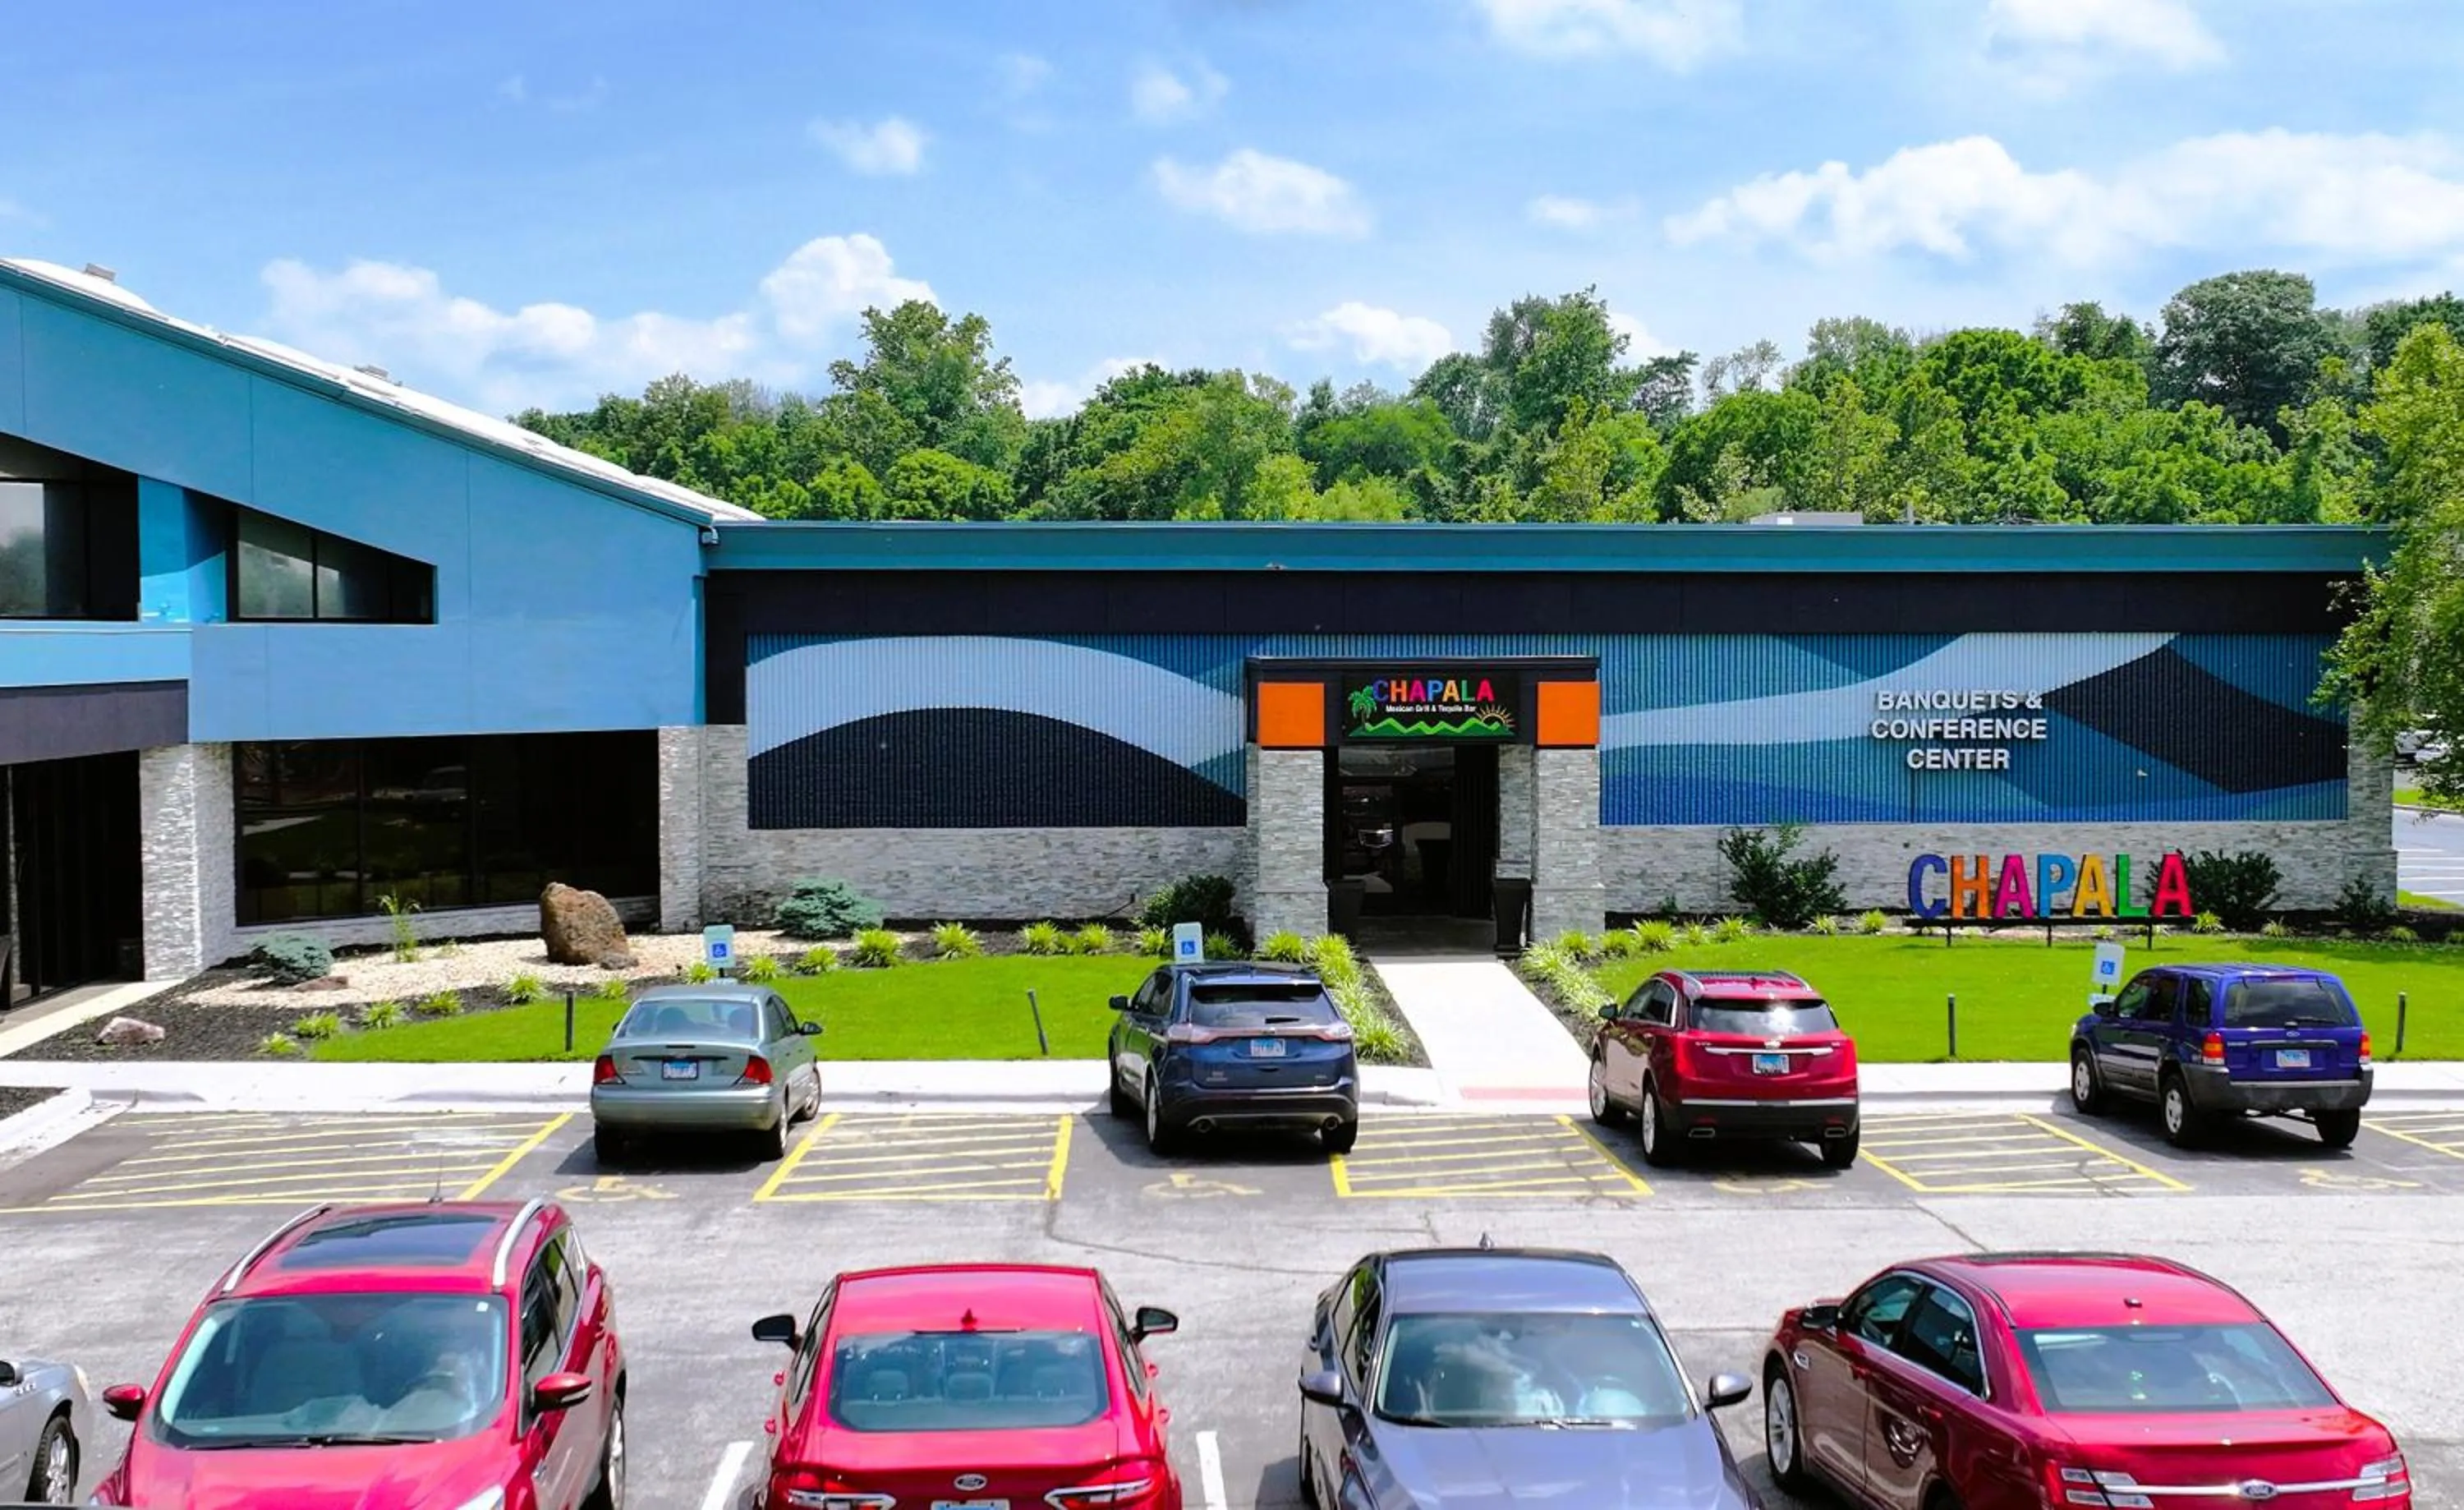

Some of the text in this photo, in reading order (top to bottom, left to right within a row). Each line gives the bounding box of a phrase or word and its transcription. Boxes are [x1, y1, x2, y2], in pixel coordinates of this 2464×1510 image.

[1372, 679, 1495, 702] CHAPALA
[1878, 690, 2043, 710] BANQUETS &
[1871, 718, 2048, 739] CONFERENCE
[1906, 748, 2011, 770] CENTER
[1908, 854, 2195, 918] CHAPALA
